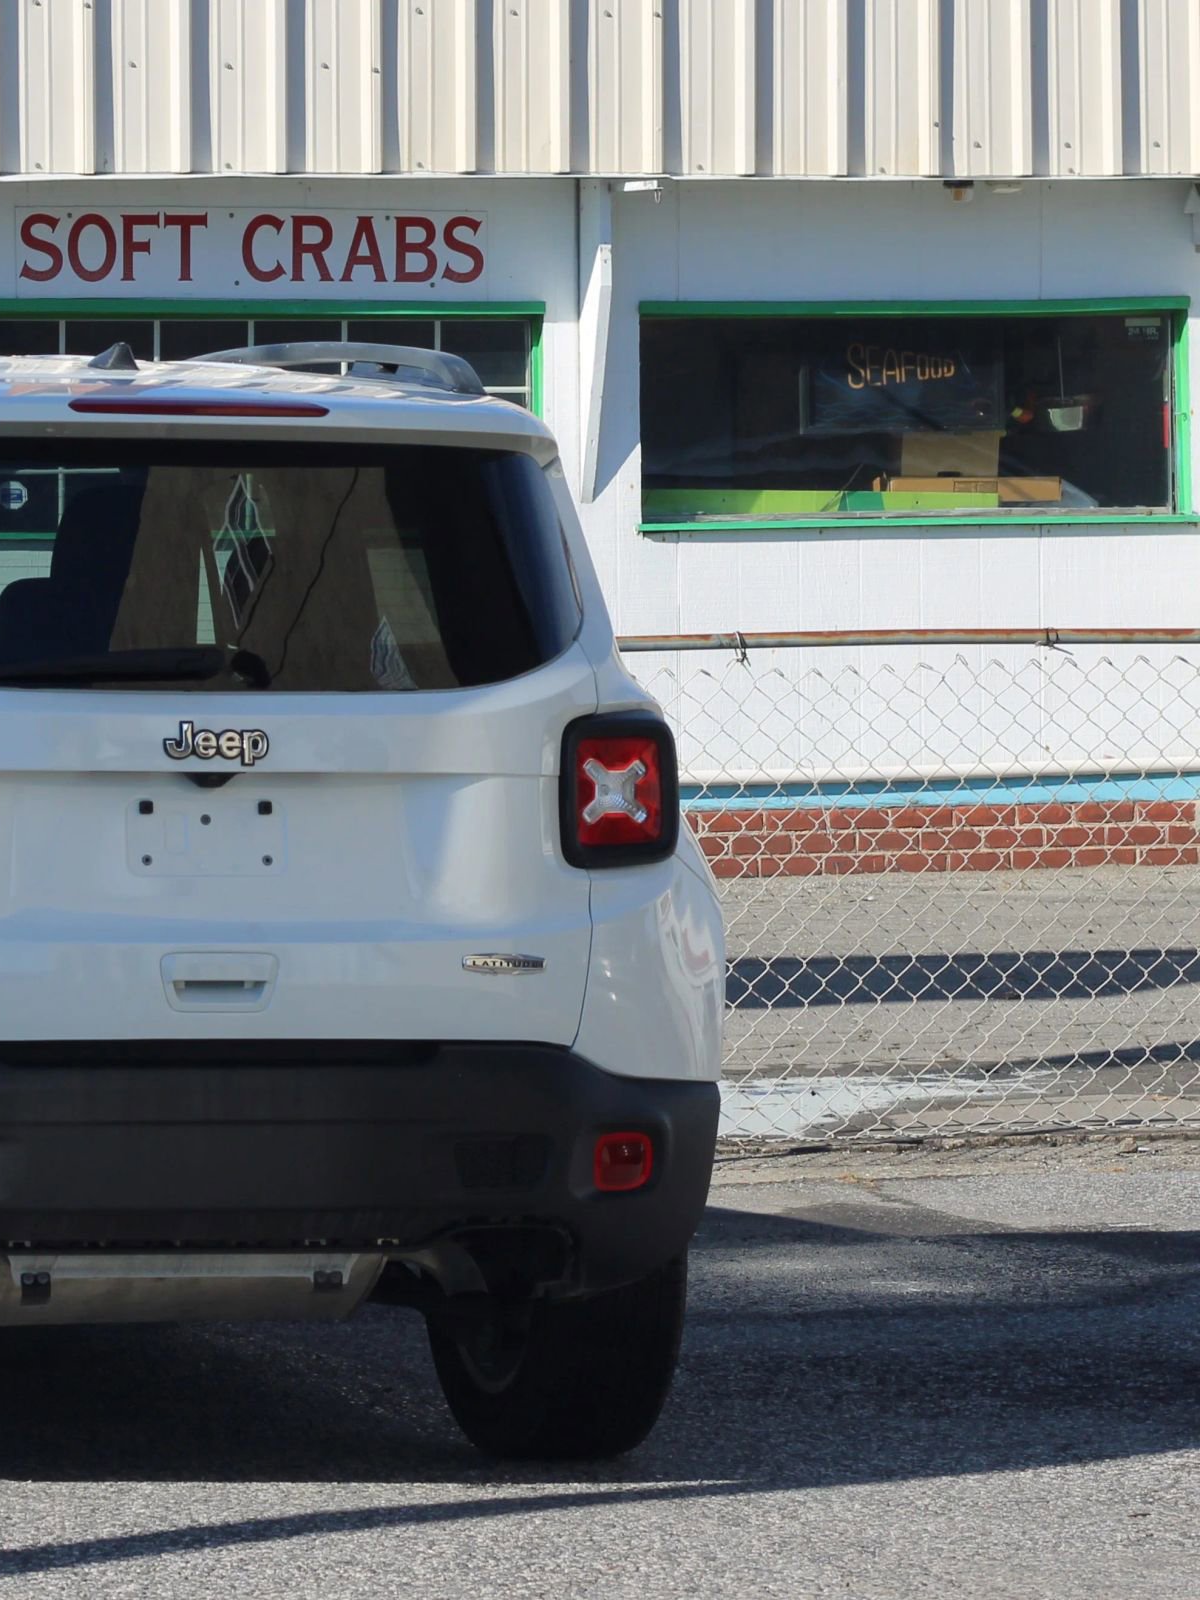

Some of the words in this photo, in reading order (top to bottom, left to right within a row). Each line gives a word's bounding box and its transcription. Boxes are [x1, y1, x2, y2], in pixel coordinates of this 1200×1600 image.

[19, 212, 208, 282] SOFT
[241, 213, 485, 284] CRABS
[847, 343, 955, 389] SEAFOOD
[163, 720, 269, 766] Jeep
